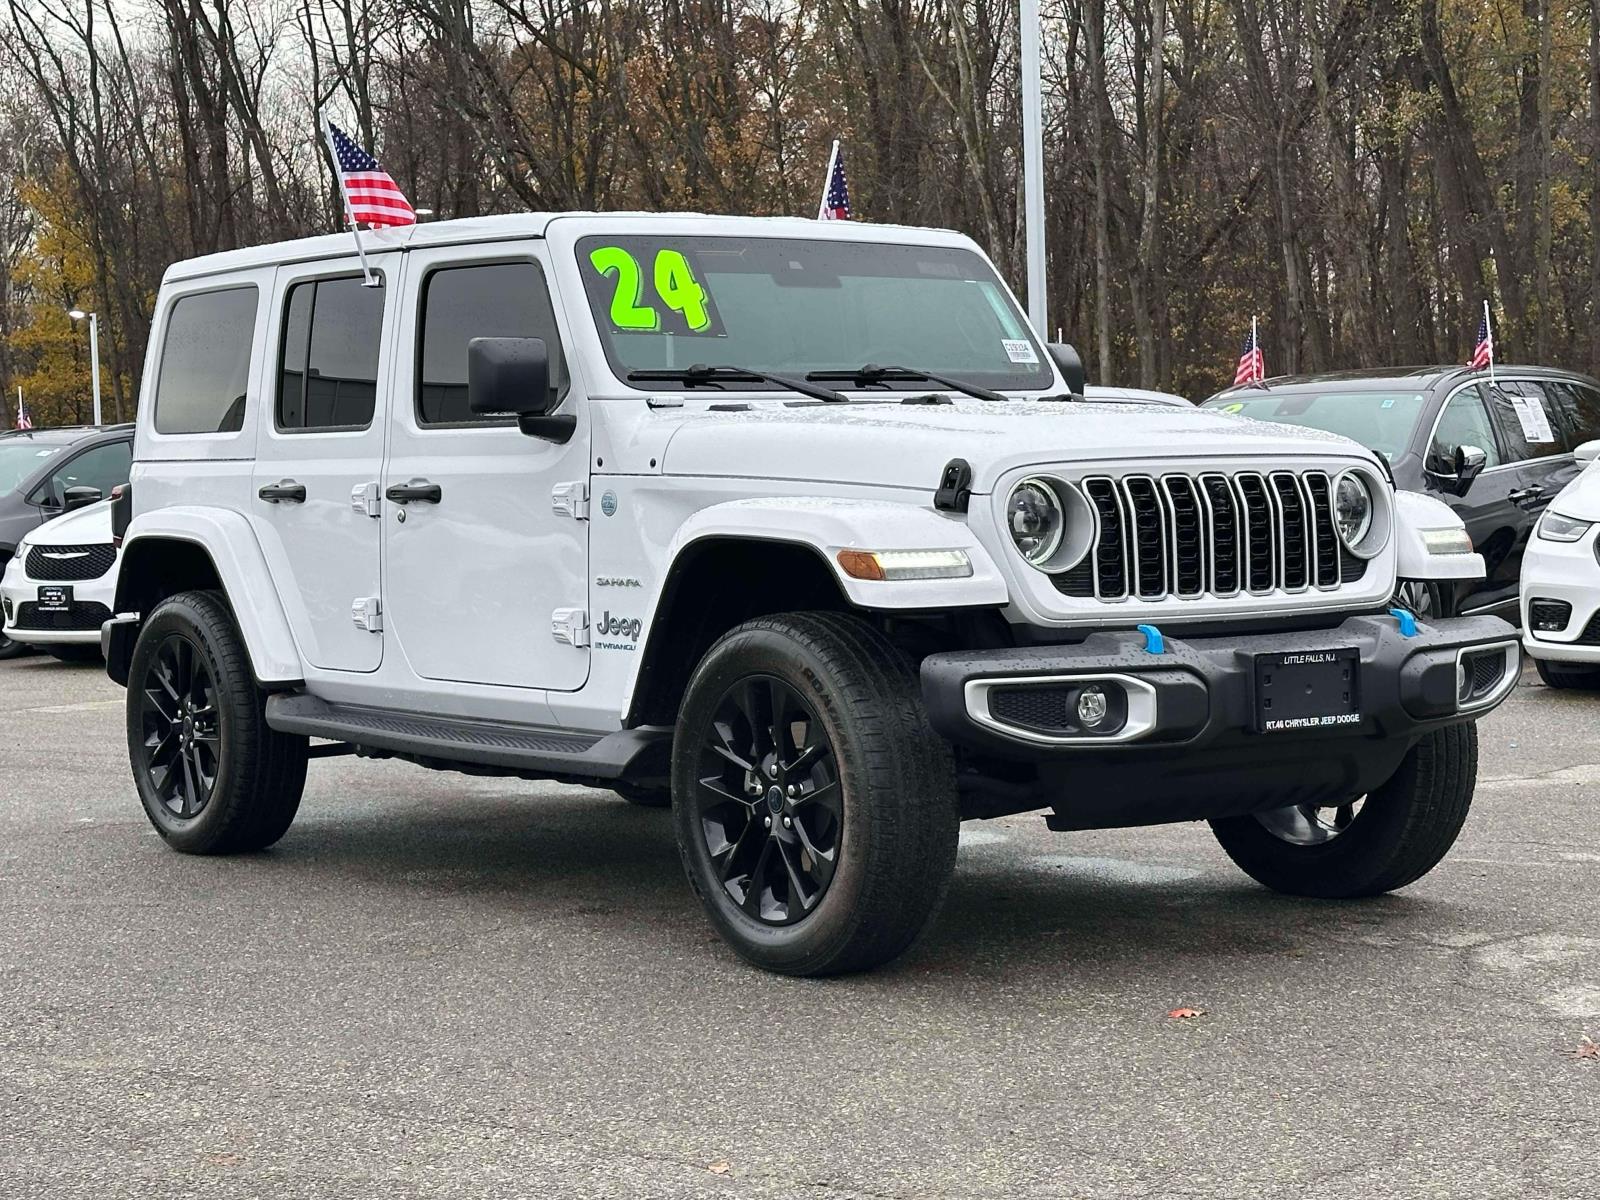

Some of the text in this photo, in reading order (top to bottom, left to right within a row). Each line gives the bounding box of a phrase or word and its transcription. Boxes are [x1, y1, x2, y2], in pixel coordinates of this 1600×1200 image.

[590, 246, 712, 333] 24
[596, 577, 642, 587] SAHARA
[596, 610, 643, 642] Jeep
[1283, 655, 1305, 665] LITTLE
[1284, 717, 1320, 728] CHRYSLER
[1320, 715, 1337, 725] JEEP
[1336, 713, 1360, 724] DODGE
